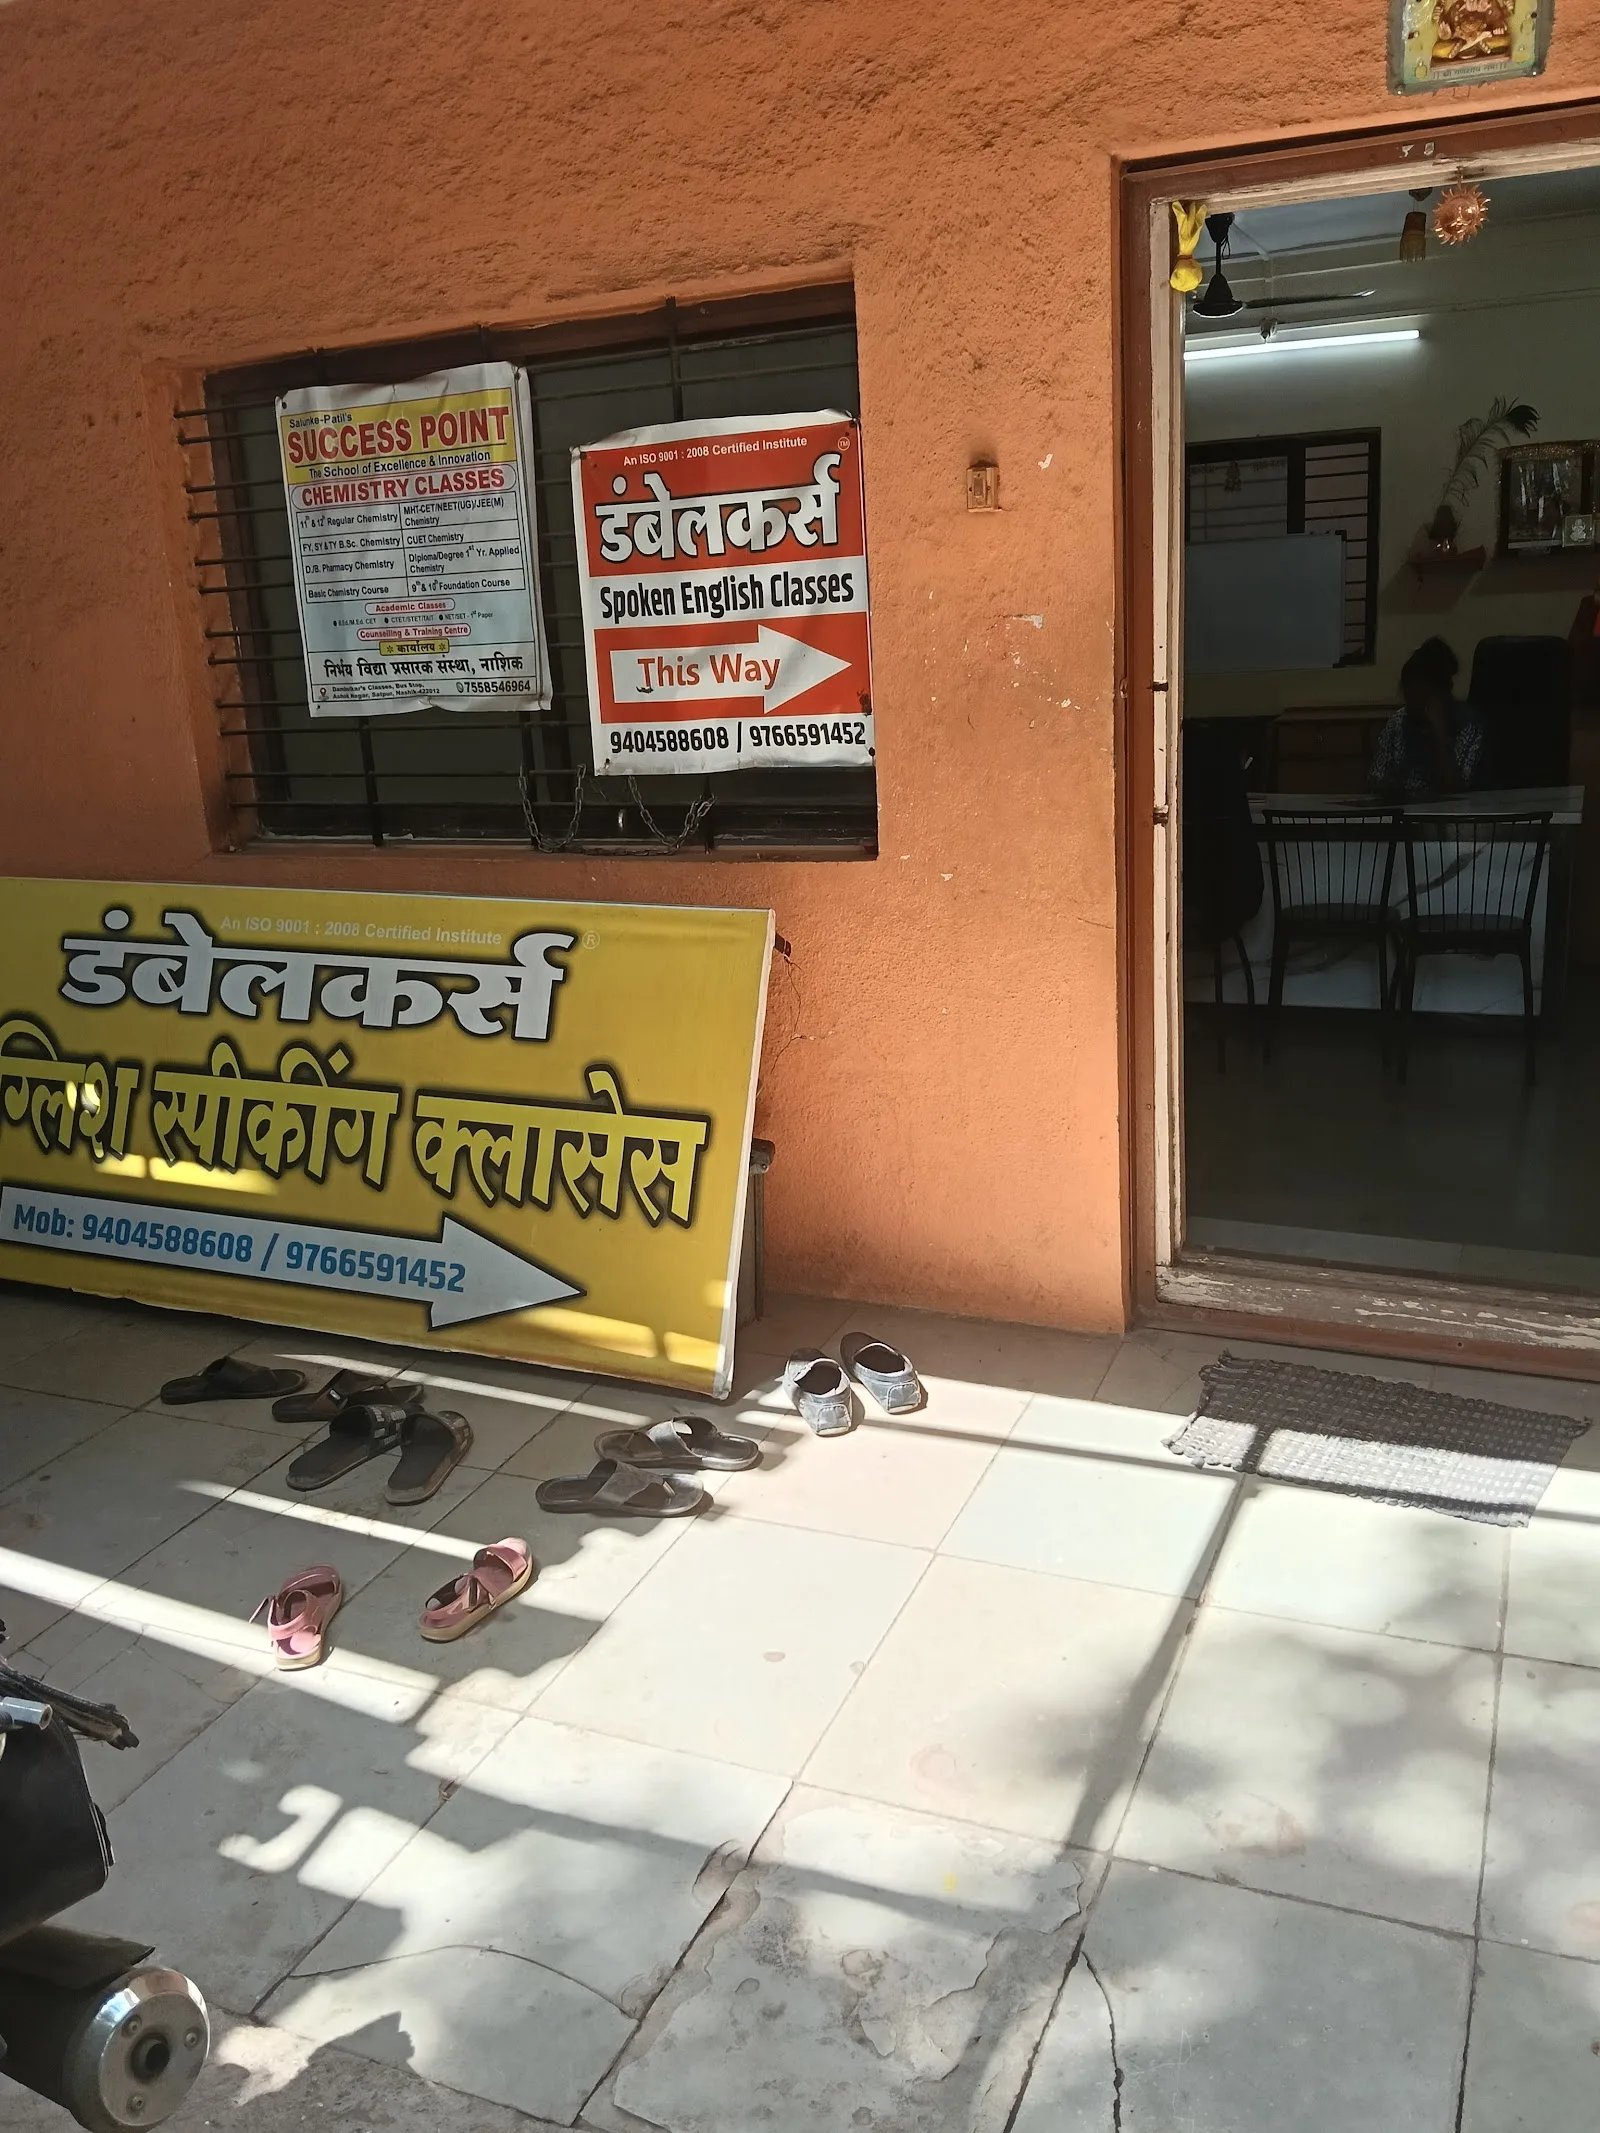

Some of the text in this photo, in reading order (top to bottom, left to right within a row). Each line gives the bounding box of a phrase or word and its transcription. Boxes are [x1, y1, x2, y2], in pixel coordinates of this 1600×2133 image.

[289, 413, 352, 428] Salunke-Patil's
[287, 406, 509, 464] SUCCESS POINT
[623, 456, 637, 467] An
[639, 453, 656, 464] ISO
[658, 451, 678, 463] 9001
[686, 446, 709, 459] 2008
[712, 441, 760, 456] Certified
[762, 437, 807, 451] Institute
[309, 451, 491, 478] The School of Excellence & Innovation
[302, 468, 504, 506] CHEMISTRY CLASSES
[595, 453, 841, 562] डंबेलकर्स
[327, 517, 354, 527] Regular
[356, 513, 398, 524] Chemistry
[405, 515, 440, 527] Chemistry
[360, 537, 400, 548] Chemistry
[406, 532, 464, 545] CUET Chemistry
[408, 550, 464, 563] Diploma/Degree
[476, 548, 487, 557] Yr.
[489, 546, 519, 558] Applied
[323, 563, 352, 573] Pharmacy
[354, 560, 394, 571] Chemistry
[409, 563, 444, 574] Chemistry
[308, 586, 389, 598] Basic Chemistry Course
[421, 583, 426, 591] &
[439, 580, 479, 591] Foundation
[481, 578, 510, 588] Course
[600, 571, 854, 624] Spoken English Classes
[376, 601, 446, 612] Academic Classes
[477, 611, 493, 620] Paper
[360, 626, 468, 639] Counselling & Training Centre
[396, 640, 435, 652] कार्यालय
[323, 651, 523, 678] निर्भय विद्या प्रसारक संस्था, नाशिक
[637, 653, 781, 690] This Way
[464, 680, 531, 693] 7558546964
[610, 721, 866, 754] 9404588608 / 9766591452
[220, 916, 241, 931] An
[245, 916, 272, 933] ISO
[276, 919, 310, 934] 9001
[324, 921, 360, 937] 2008
[365, 923, 432, 942] Certified
[436, 926, 502, 945] Institute
[61, 909, 575, 1041] डंबेलकर्स
[414, 1067, 708, 1223] क्लासेस
[13, 1203, 467, 1293] Mob: 9404588608 / 9766591452
